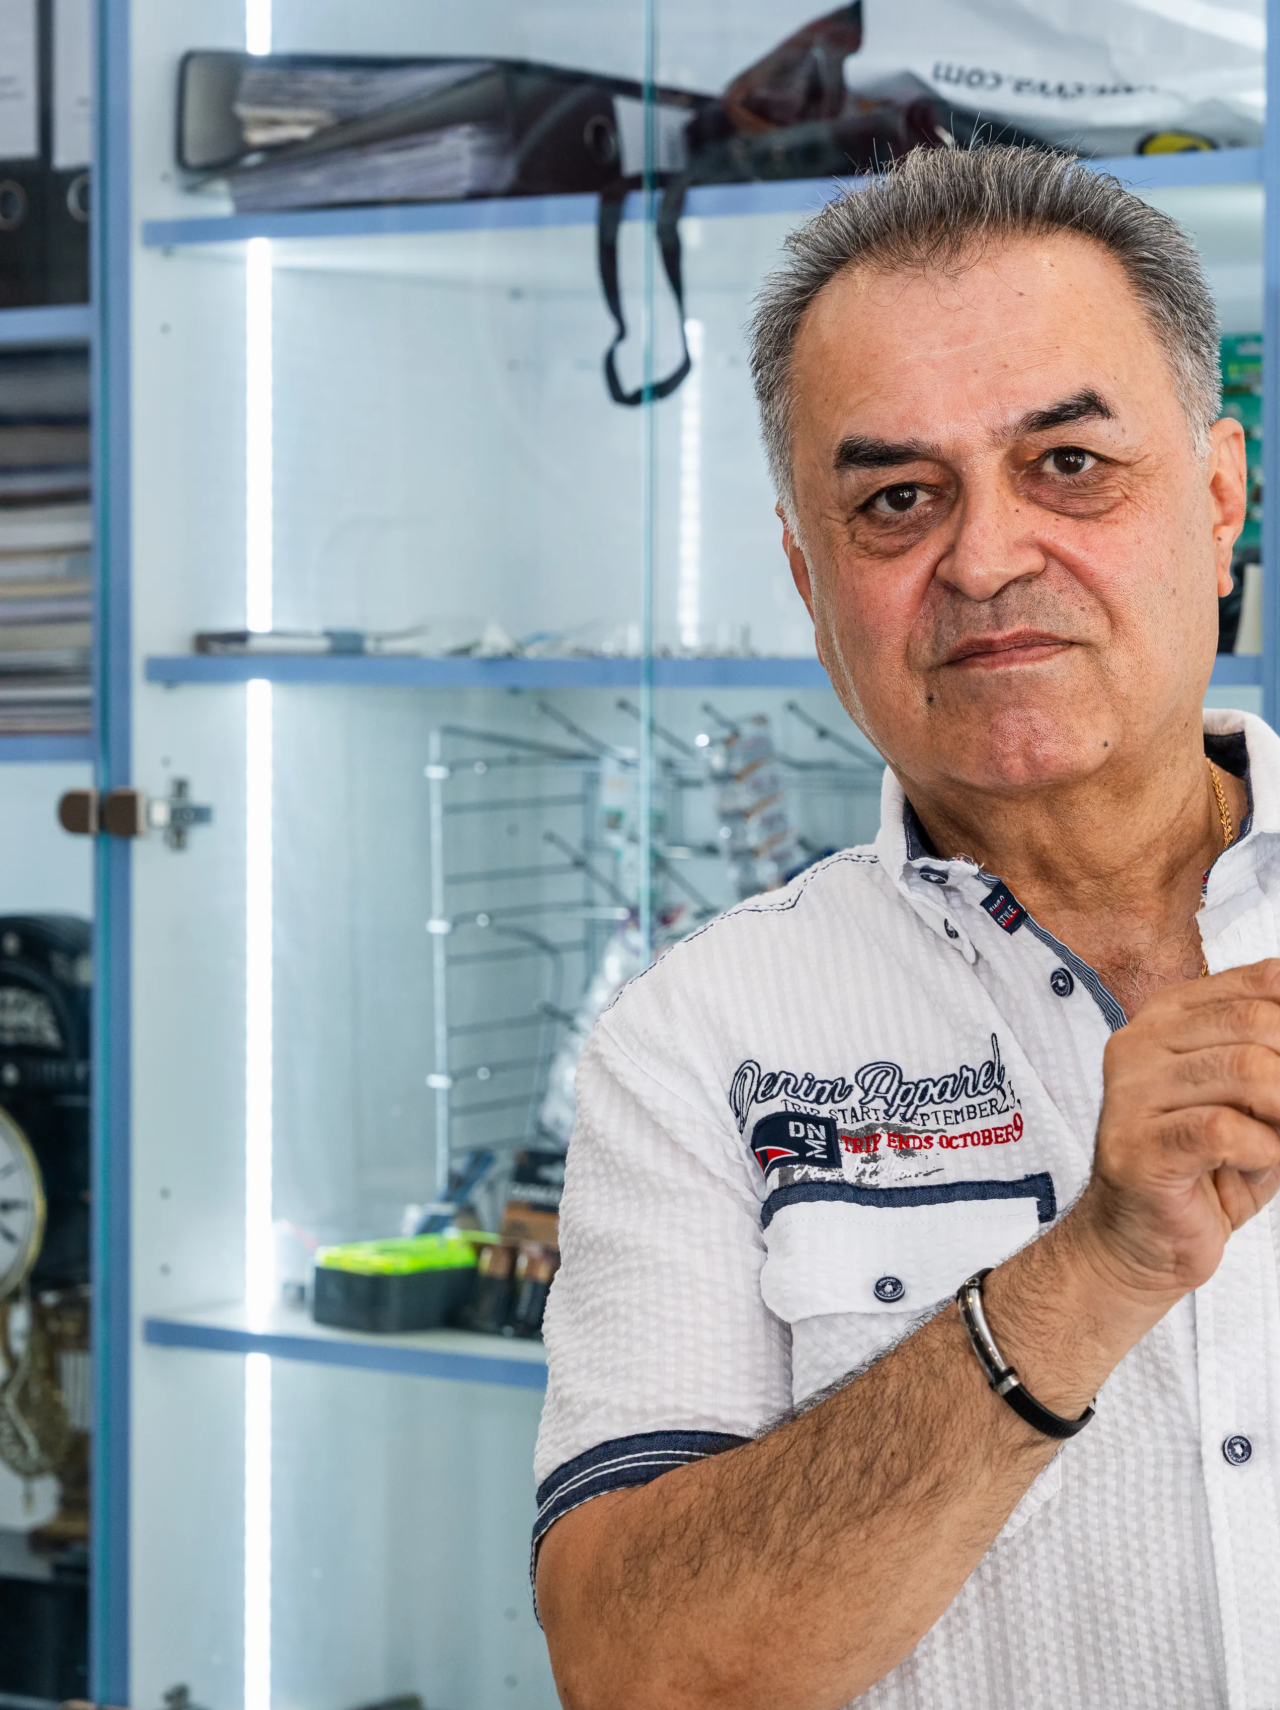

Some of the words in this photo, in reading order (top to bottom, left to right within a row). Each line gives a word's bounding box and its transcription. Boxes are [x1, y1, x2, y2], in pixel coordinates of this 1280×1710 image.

[997, 904, 1018, 927] STYLE
[730, 1059, 854, 1134] Denim
[855, 1033, 1006, 1121] Apparel
[841, 1133, 882, 1153] TRIP
[886, 1132, 934, 1150] ENDS
